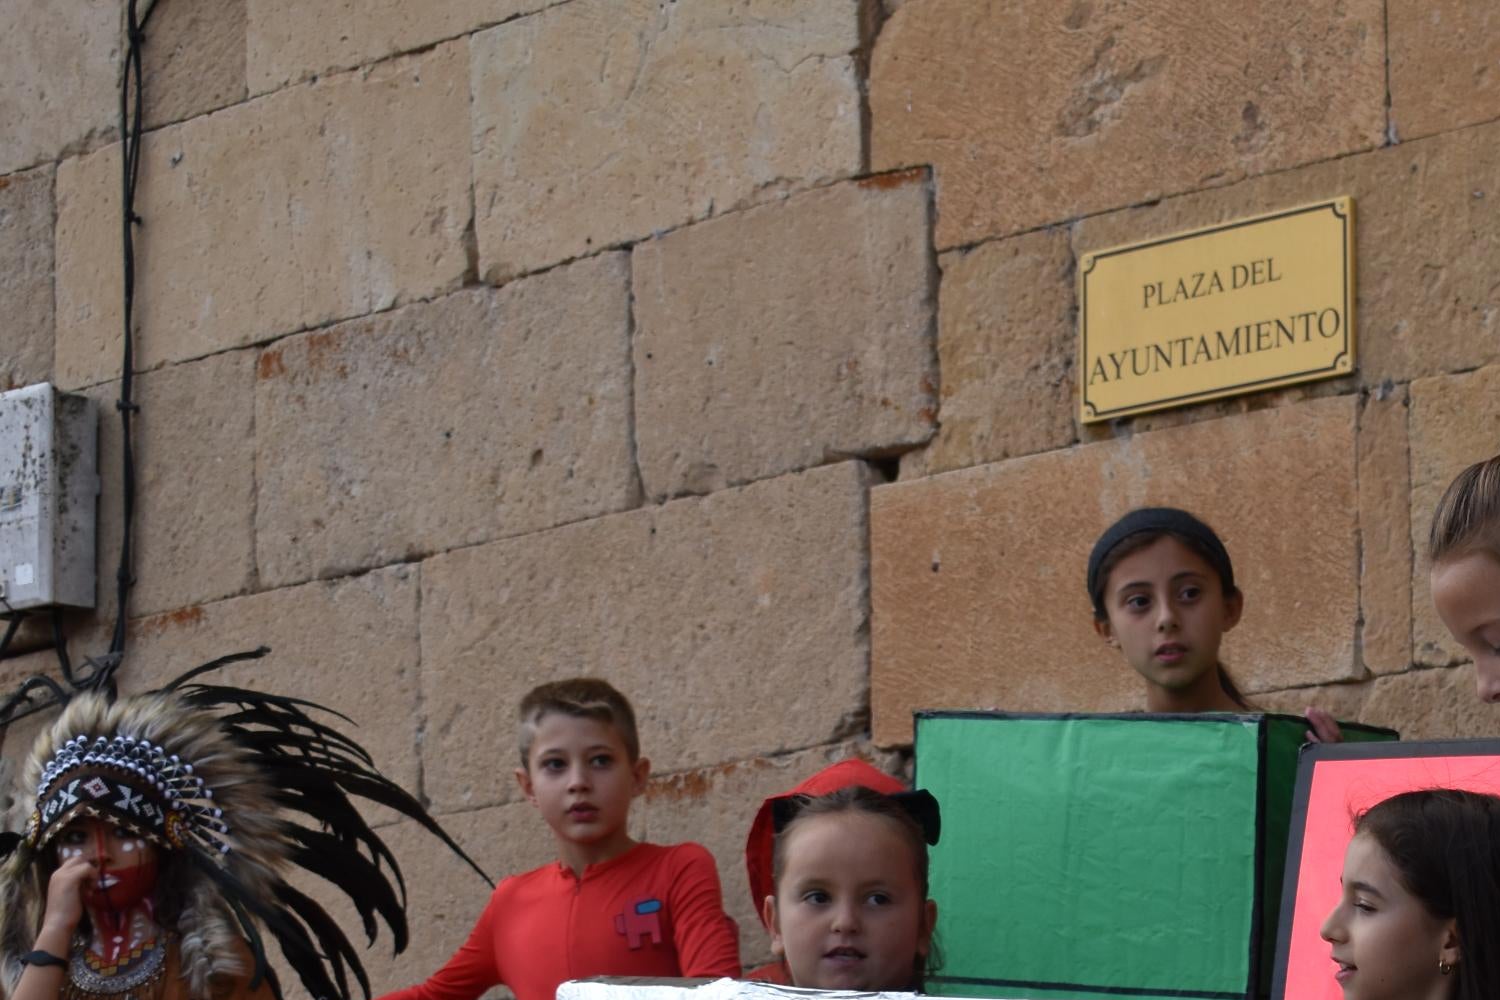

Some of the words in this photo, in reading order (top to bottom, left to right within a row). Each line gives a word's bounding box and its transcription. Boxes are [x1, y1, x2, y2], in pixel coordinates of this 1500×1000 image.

[1142, 270, 1225, 308] PLAZA
[1231, 258, 1282, 290] DEL
[1088, 307, 1341, 385] AYUNTAMIENTO
